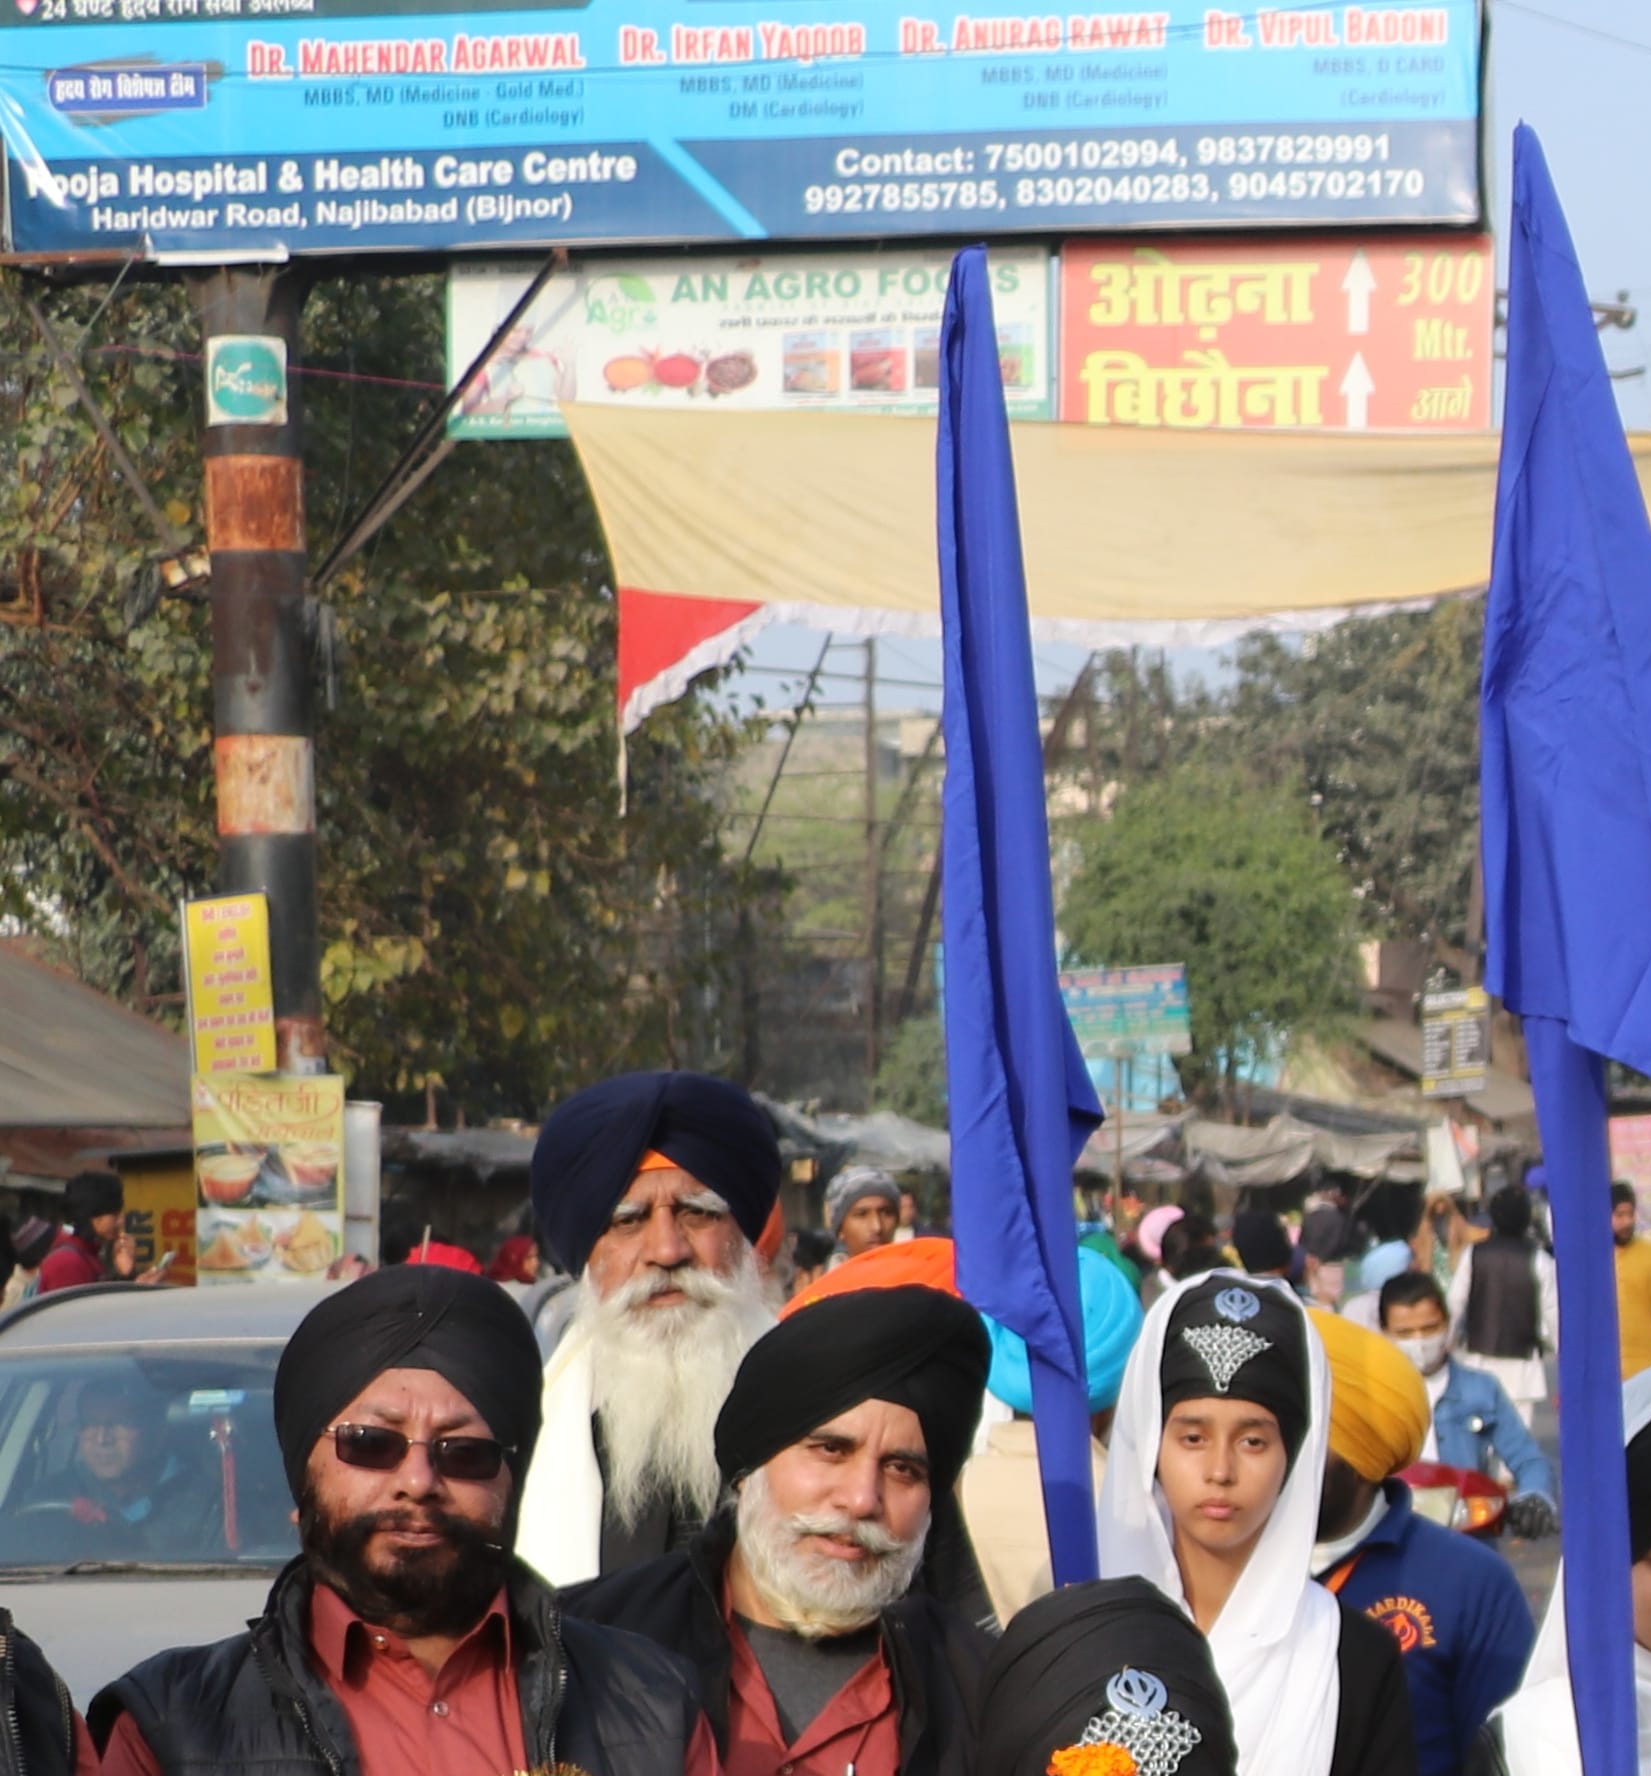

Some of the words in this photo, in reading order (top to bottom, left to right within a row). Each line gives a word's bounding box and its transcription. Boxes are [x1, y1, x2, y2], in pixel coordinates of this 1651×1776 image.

[672, 24, 753, 63] IRFAN
[757, 21, 866, 66] YAQOOB
[953, 15, 1061, 52] ANURAG
[1067, 11, 1170, 49] RAWAT
[1257, 8, 1338, 47] VIPUL
[1344, 7, 1447, 46] BADONI
[299, 38, 447, 78] MAHENDAR
[452, 32, 586, 72] AGARWAL
[366, 87, 394, 104] MD
[495, 81, 534, 99] Gold
[742, 74, 770, 92] MD
[443, 110, 479, 128] DNB
[129, 161, 267, 201] Hospital
[278, 160, 303, 192] &
[314, 156, 424, 191] Health
[434, 154, 514, 188] Care
[523, 151, 637, 185] Centre
[836, 147, 975, 177] Contact:
[985, 138, 1187, 172] 7500102994,
[1197, 134, 1389, 164] 9837829991
[92, 205, 219, 231] Haridwar
[226, 202, 307, 229] Road,
[316, 197, 457, 230] Najibabad
[466, 192, 573, 225] (Bijnor)
[805, 179, 1007, 214] 9927855785,
[1016, 172, 1218, 208] 8302040283,
[1228, 168, 1424, 199] 9045702170
[671, 272, 729, 303] AN
[745, 268, 861, 301] AGRO
[877, 264, 1020, 297] FOOS
[1089, 248, 1321, 340] ओढ़ना
[1398, 252, 1485, 307] 300
[1413, 318, 1473, 360] Mtr.
[1079, 349, 1329, 427] बिछौना
[1410, 375, 1473, 420] आगे
